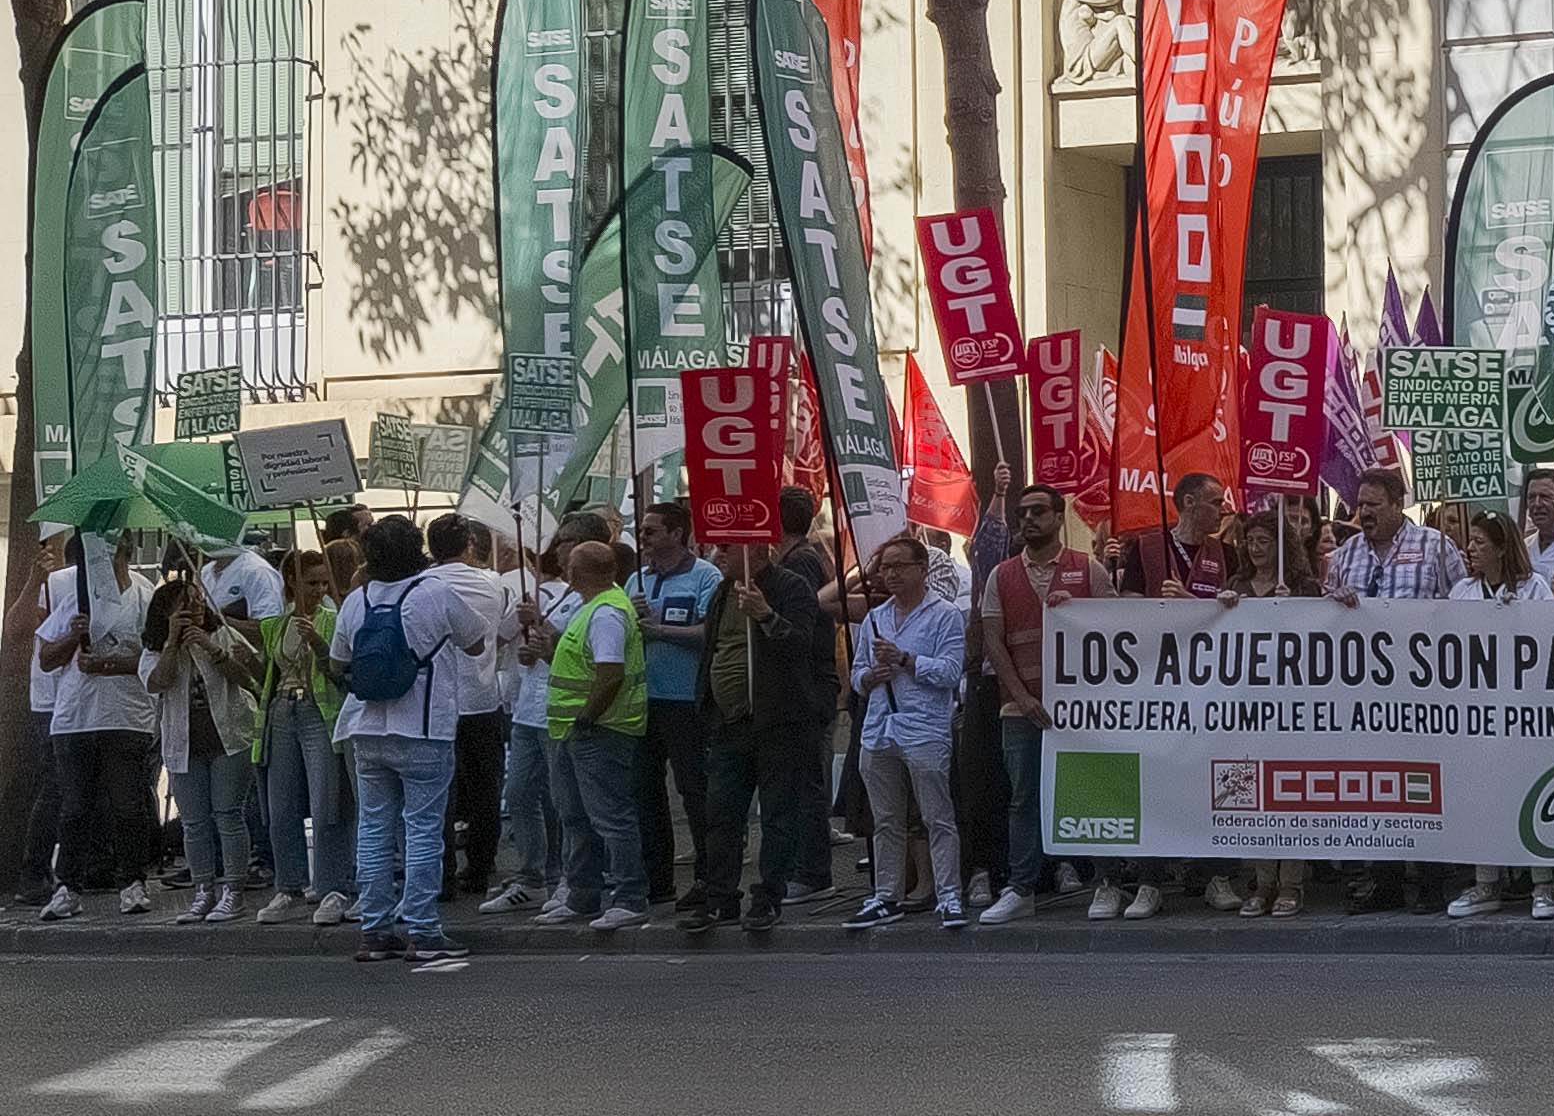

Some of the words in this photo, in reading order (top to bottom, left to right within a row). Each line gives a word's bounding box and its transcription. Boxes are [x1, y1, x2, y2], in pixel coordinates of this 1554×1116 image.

[649, 28, 705, 336] SATSE
[1491, 198, 1551, 219] SATSE
[785, 89, 874, 424] SATSE
[931, 216, 998, 335] UGT
[513, 358, 573, 383] SATSE
[1389, 350, 1502, 378] SATSE
[180, 368, 241, 397] SATSE
[1259, 317, 1312, 442] UGT
[1389, 379, 1474, 393] SINDICATO
[1479, 381, 1500, 394] DE
[1039, 338, 1073, 449] UGT
[1388, 392, 1500, 406] ENFERMERIA
[177, 413, 238, 438] MALAGA
[1387, 405, 1499, 428] MALAGA
[699, 375, 757, 496] UGT
[1415, 453, 1480, 467] SINDCATO
[1483, 451, 1502, 463] DE
[1416, 475, 1502, 501] MALAGA
[1055, 631, 1139, 686] LOS
[1154, 631, 1396, 687] ACUERDOS
[1408, 632, 1498, 689] SON
[1053, 699, 1197, 735] CONSEJERA,
[1205, 700, 1306, 732] CUMPLE
[1313, 701, 1342, 732] EL
[1350, 701, 1459, 736] ACUERDO
[1466, 705, 1497, 737] DE
[1273, 771, 1401, 803] CCOO
[1058, 816, 1136, 840] SATSE
[1212, 813, 1285, 829] federación
[1290, 814, 1308, 829] de
[1313, 815, 1369, 830] sanidad
[1372, 818, 1381, 832] y
[1384, 817, 1443, 831] sectores
[1211, 833, 1320, 848] sociosanitarios
[1324, 834, 1342, 848] de
[1345, 834, 1416, 850] Andalucía
